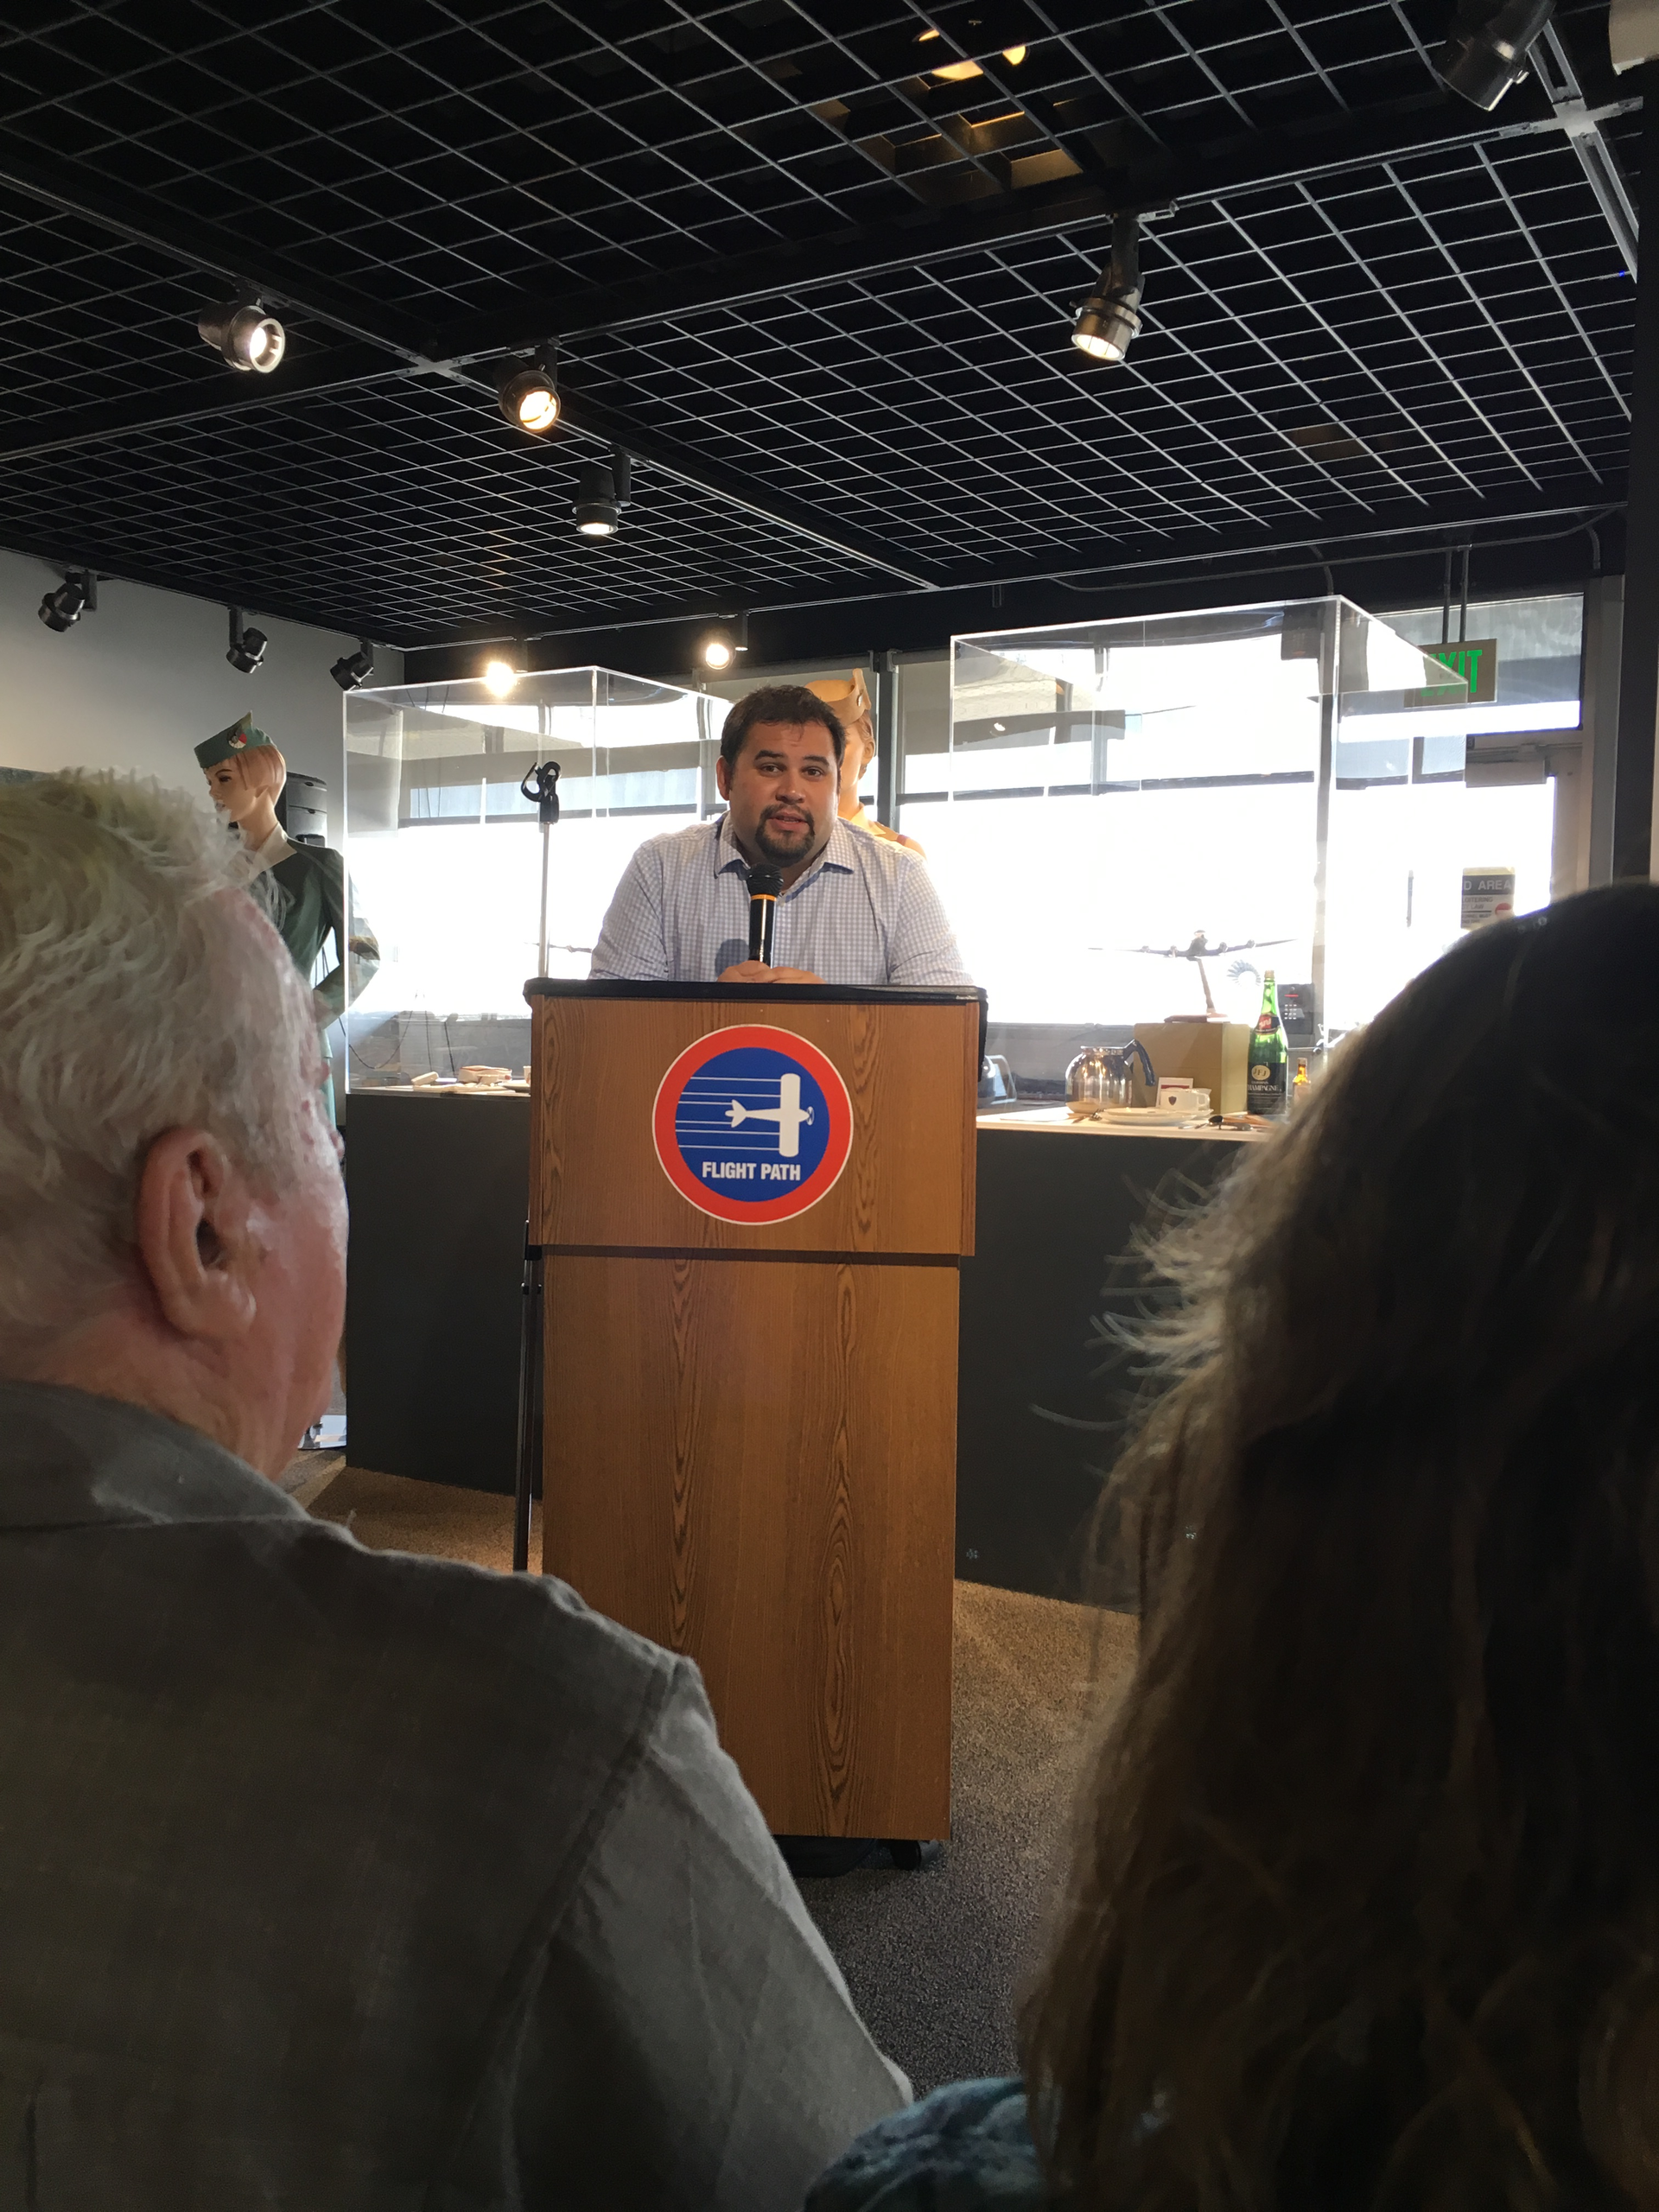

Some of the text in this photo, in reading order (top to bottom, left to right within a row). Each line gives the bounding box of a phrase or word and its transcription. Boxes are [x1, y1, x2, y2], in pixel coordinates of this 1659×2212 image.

[1464, 880, 1512, 891] D AREA
[702, 1161, 801, 1181] FLIGHT PATH
